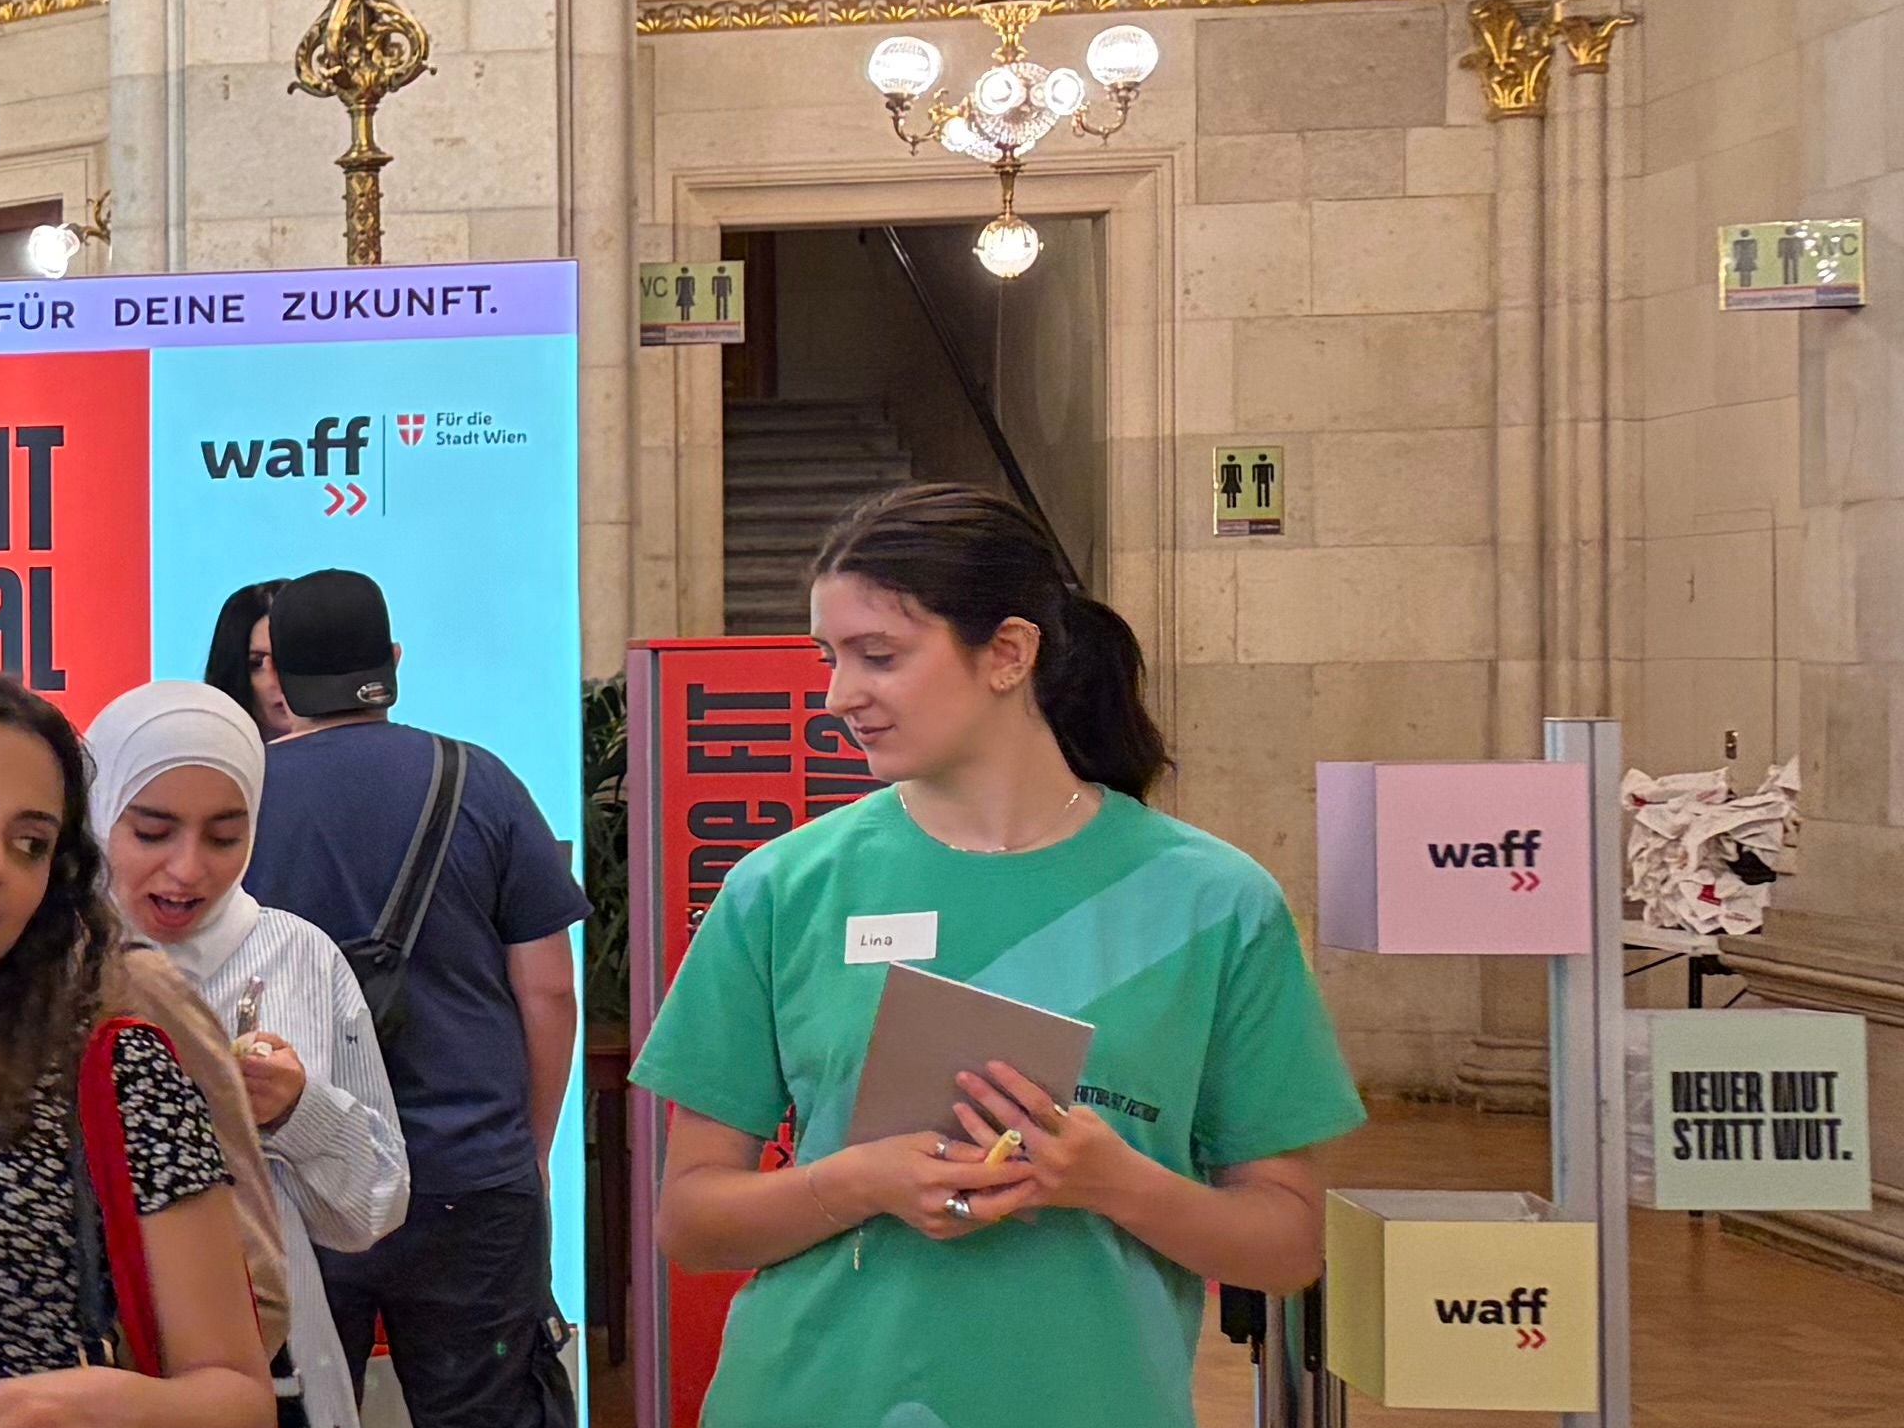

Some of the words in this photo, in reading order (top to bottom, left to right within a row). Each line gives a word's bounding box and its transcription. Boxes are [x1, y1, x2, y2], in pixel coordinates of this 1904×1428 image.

[113, 294, 245, 328] DEINE
[281, 285, 498, 321] ZUKUNFT.
[436, 412, 462, 428] Für
[466, 412, 493, 428] die
[436, 428, 479, 447] Stadt
[482, 428, 527, 445] Wien
[201, 417, 371, 480] waff
[1428, 829, 1541, 870] waff
[860, 933, 893, 947] Lina
[1672, 1070, 1764, 1115] NEUER
[1772, 1071, 1838, 1114] MUT
[1673, 1117, 1764, 1162] STATT
[1772, 1117, 1853, 1161] WUT.
[1435, 1287, 1548, 1326] waff
